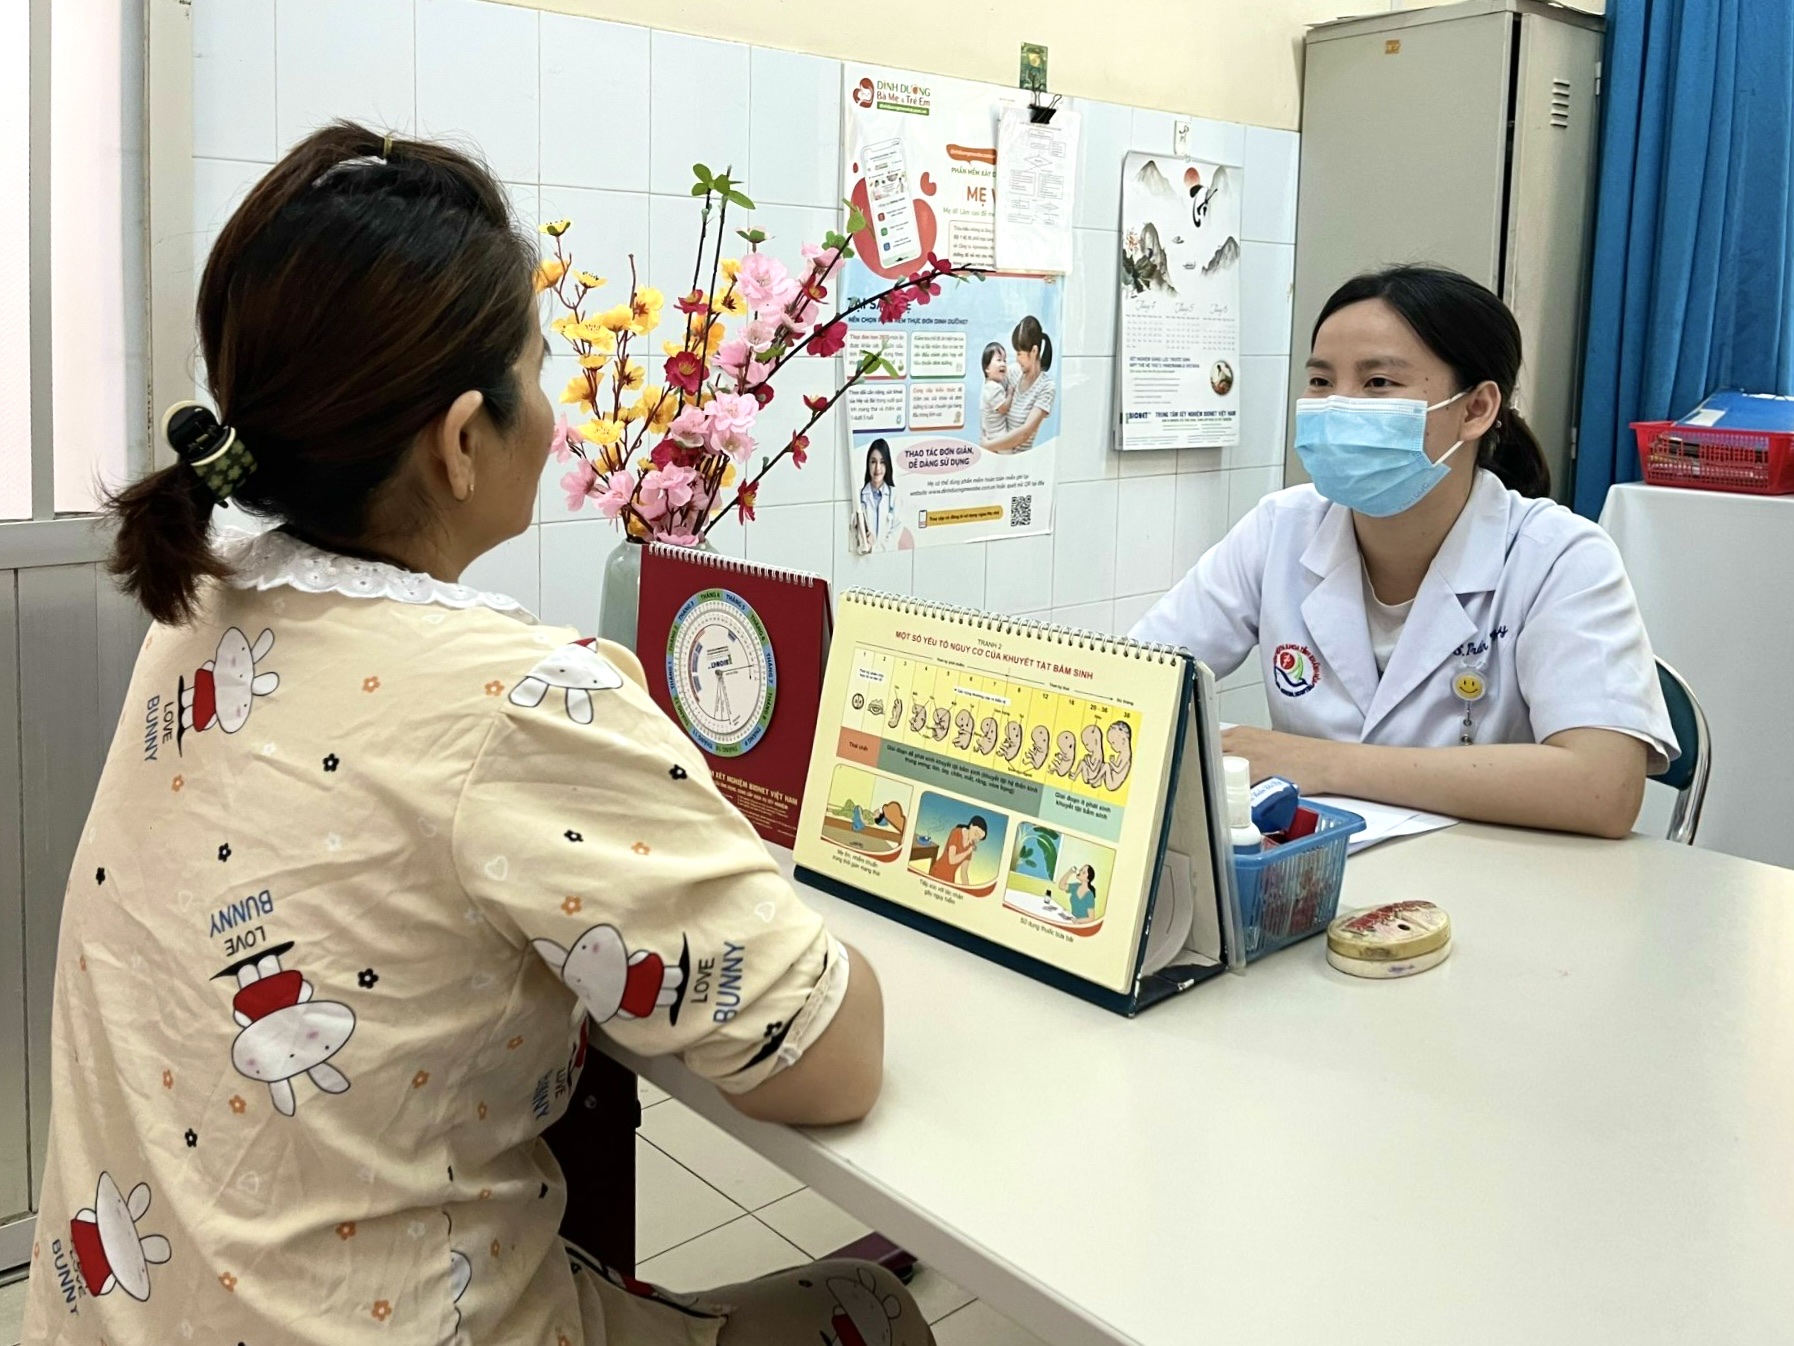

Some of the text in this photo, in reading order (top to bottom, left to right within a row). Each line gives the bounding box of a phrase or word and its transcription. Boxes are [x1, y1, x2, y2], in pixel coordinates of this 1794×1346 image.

[918, 97, 930, 106] Em
[967, 186, 987, 207] MẸ
[905, 450, 924, 458] THAO
[926, 448, 938, 456] TÁC
[940, 447, 955, 456] ĐƠN
[919, 458, 938, 468] DÀNG
[950, 458, 970, 468] DỤNG
[895, 631, 910, 640] MỘT
[912, 632, 922, 642] SỐ
[924, 636, 937, 646] YẾU
[950, 642, 970, 653] NGUY
[972, 647, 984, 656] CƠ
[985, 649, 1001, 660] CỦA
[1002, 655, 1035, 667] KHUYẾT
[1036, 660, 1051, 671] TẬT
[1053, 664, 1072, 675] BẨM
[1073, 669, 1094, 680] SINH
[978, 639, 997, 649] TRANH
[144, 694, 160, 762] BUNNY
[162, 701, 174, 744] LOVE
[210, 889, 274, 938] BUNNY
[224, 925, 266, 957] LOVE
[690, 957, 716, 1003] LOVE
[713, 941, 746, 1022] BUNNY
[52, 1238, 79, 1316] BUNNY
